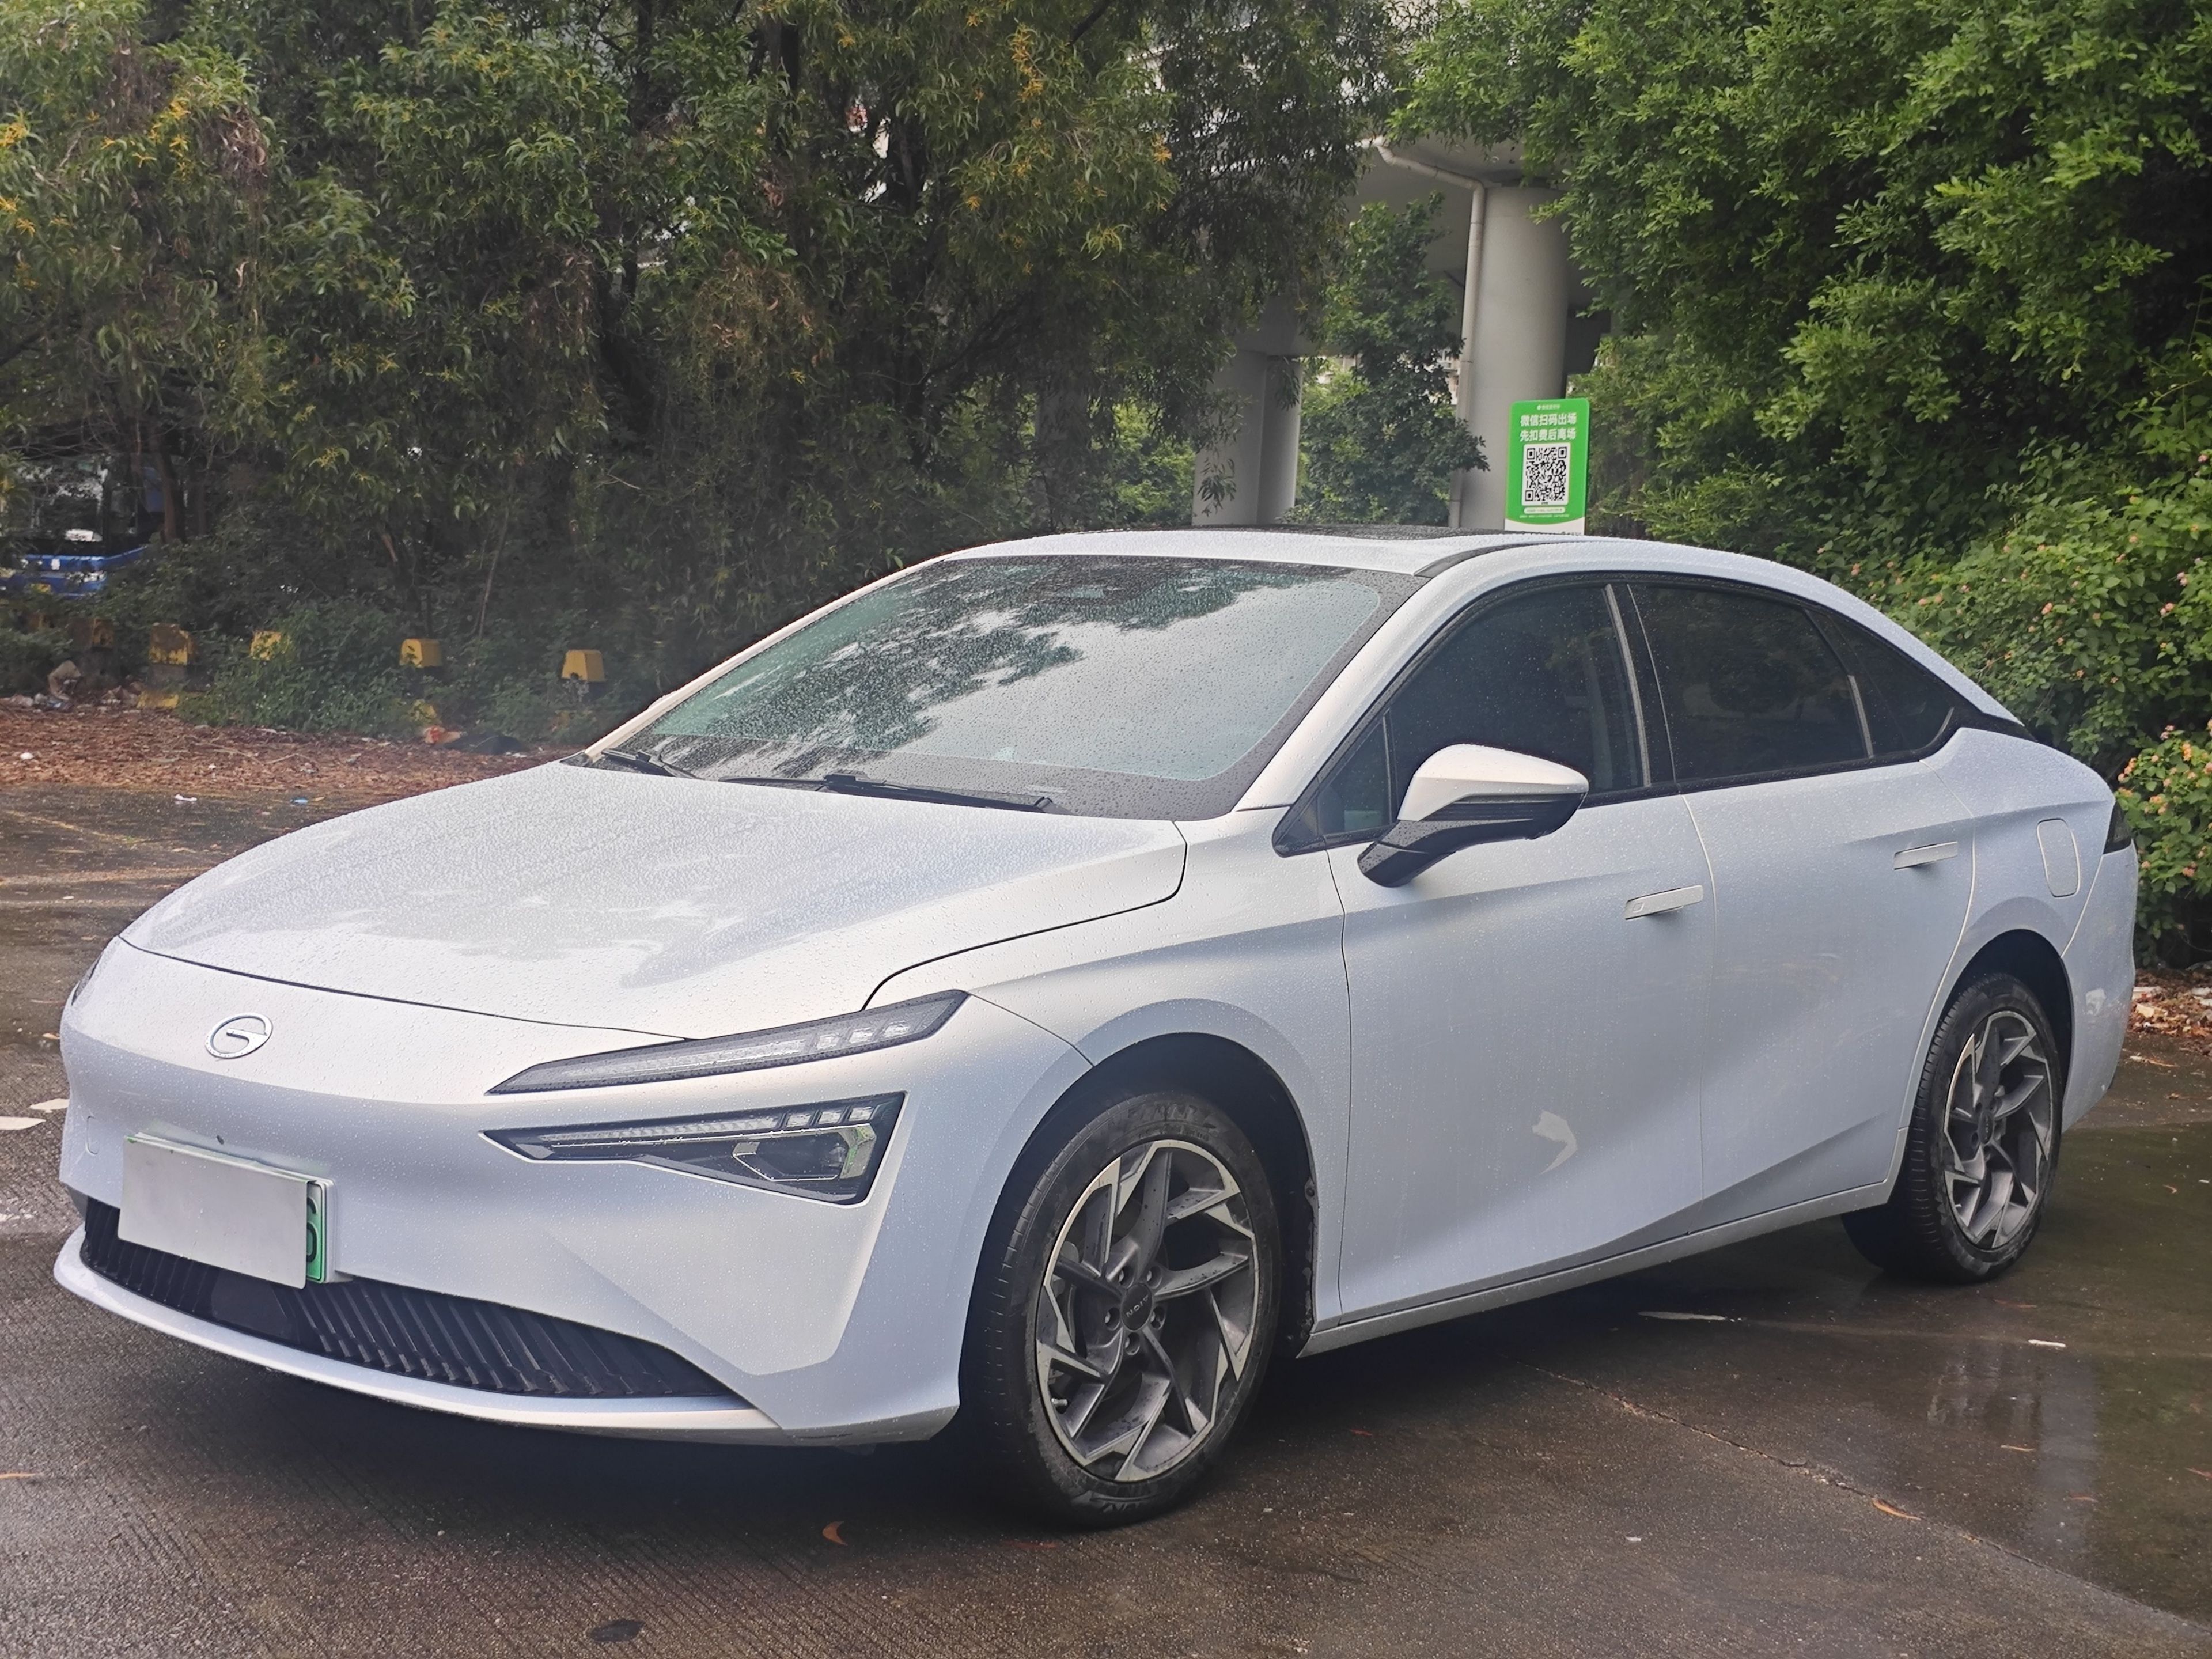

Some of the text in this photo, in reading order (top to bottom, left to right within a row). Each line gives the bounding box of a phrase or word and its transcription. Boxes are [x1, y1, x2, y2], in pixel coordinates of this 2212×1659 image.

[1520, 412, 1577, 427] 微信扫码出场
[1520, 428, 1576, 442] 先扣费后离场
[1126, 1294, 1149, 1318] AION
